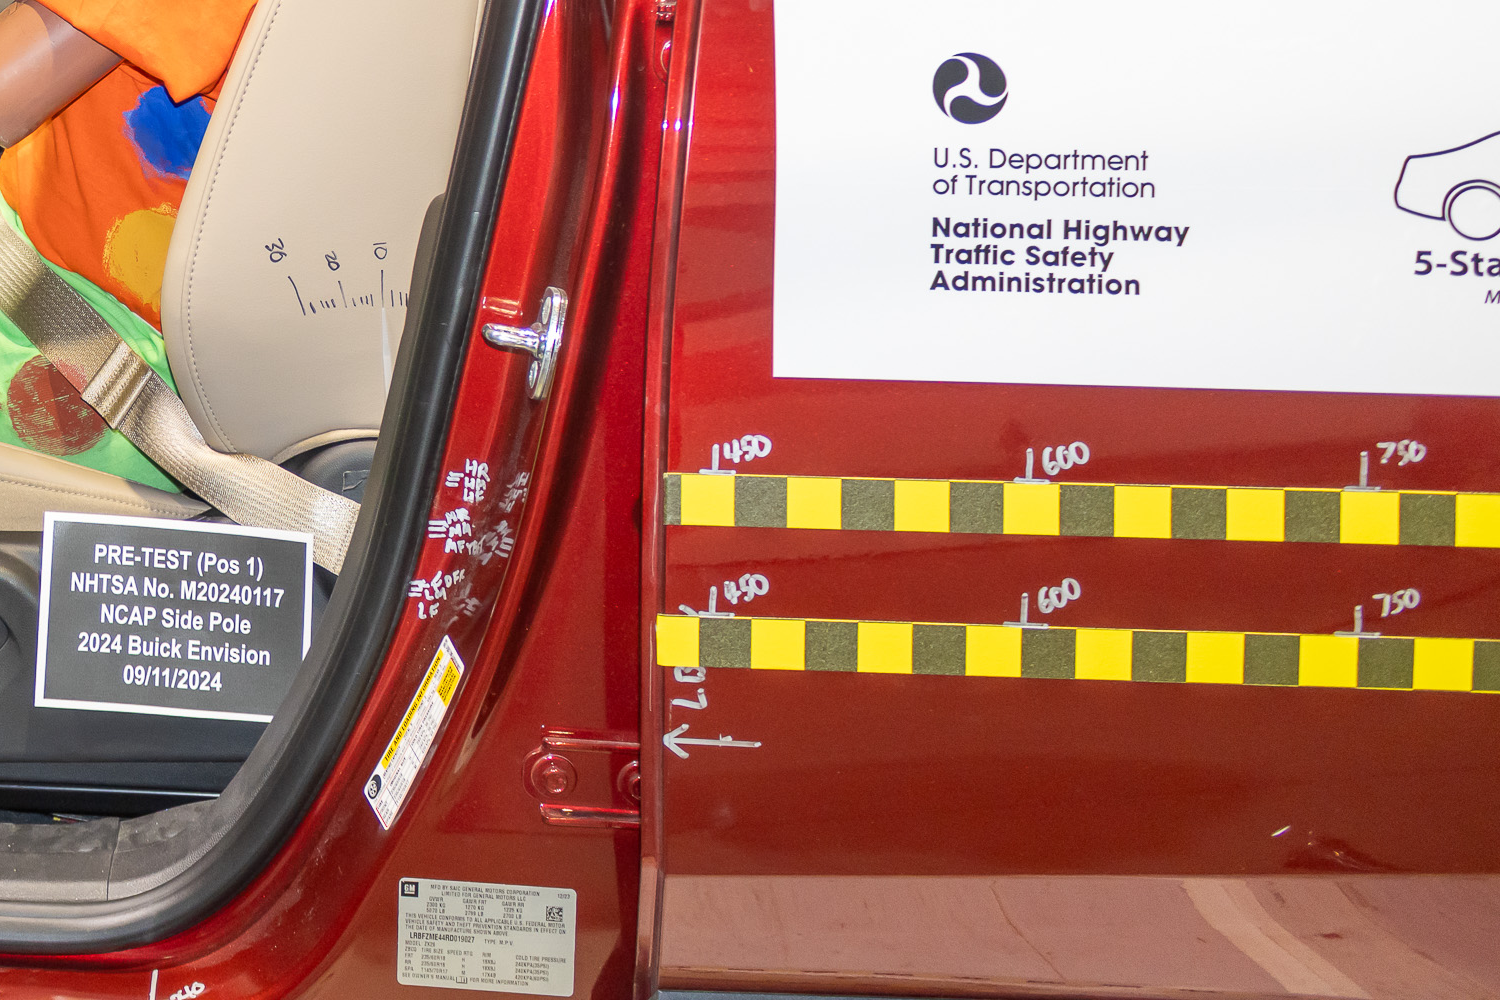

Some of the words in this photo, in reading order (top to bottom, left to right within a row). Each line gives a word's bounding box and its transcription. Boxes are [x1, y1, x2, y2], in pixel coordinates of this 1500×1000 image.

[933, 147, 979, 168] U.S.
[989, 148, 1149, 174] Department
[932, 175, 958, 195] of
[965, 175, 1156, 201] Transportation
[932, 217, 1052, 239] National
[1063, 219, 1190, 247] Highway
[930, 243, 1016, 266] Traffic
[1025, 245, 1115, 272] Safety
[930, 270, 1141, 295] Administration
[723, 434, 773, 464] 450
[1041, 441, 1091, 476] 600
[1376, 439, 1427, 467] 750
[94, 544, 192, 571] PRE-TEST
[197, 552, 240, 577] (Pos
[247, 557, 264, 581] 1)
[70, 572, 138, 596] NHTSA
[143, 577, 174, 599] No.
[180, 580, 285, 608] M20240117
[1037, 577, 1081, 614] 600
[1371, 587, 1421, 618] 750
[100, 603, 156, 626] NCAP
[161, 608, 204, 631] Side
[209, 611, 252, 634] Pole
[77, 631, 123, 653] 2024
[128, 635, 182, 659] Buick
[187, 639, 271, 666] Envision
[123, 664, 222, 692] 09/11/2024
[404, 883, 415, 891] GM
